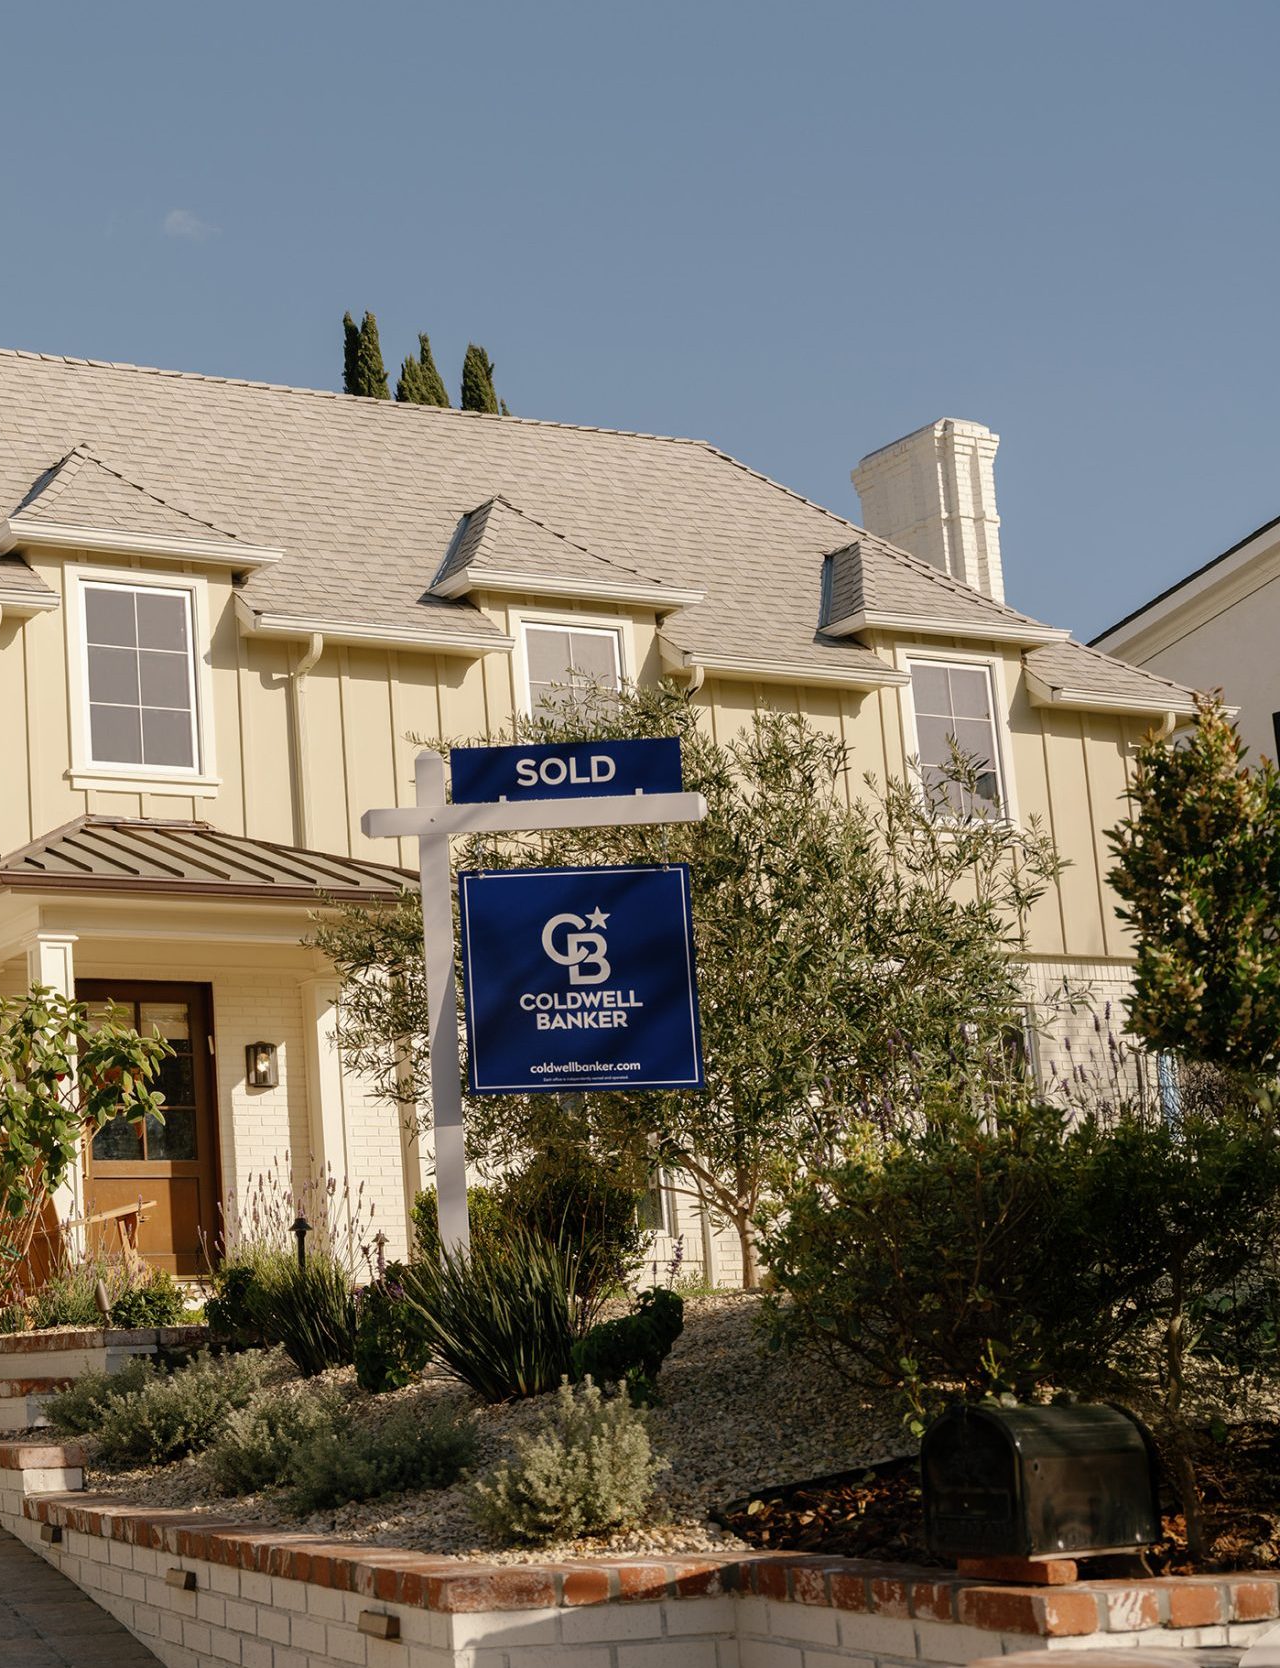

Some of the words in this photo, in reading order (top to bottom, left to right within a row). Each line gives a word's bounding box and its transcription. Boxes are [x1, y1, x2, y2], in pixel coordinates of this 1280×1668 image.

[516, 755, 616, 786] SOLD
[520, 990, 643, 1010] COLDWELL
[536, 1010, 628, 1030] BANKER
[530, 1061, 641, 1074] coldwellbanker.com
